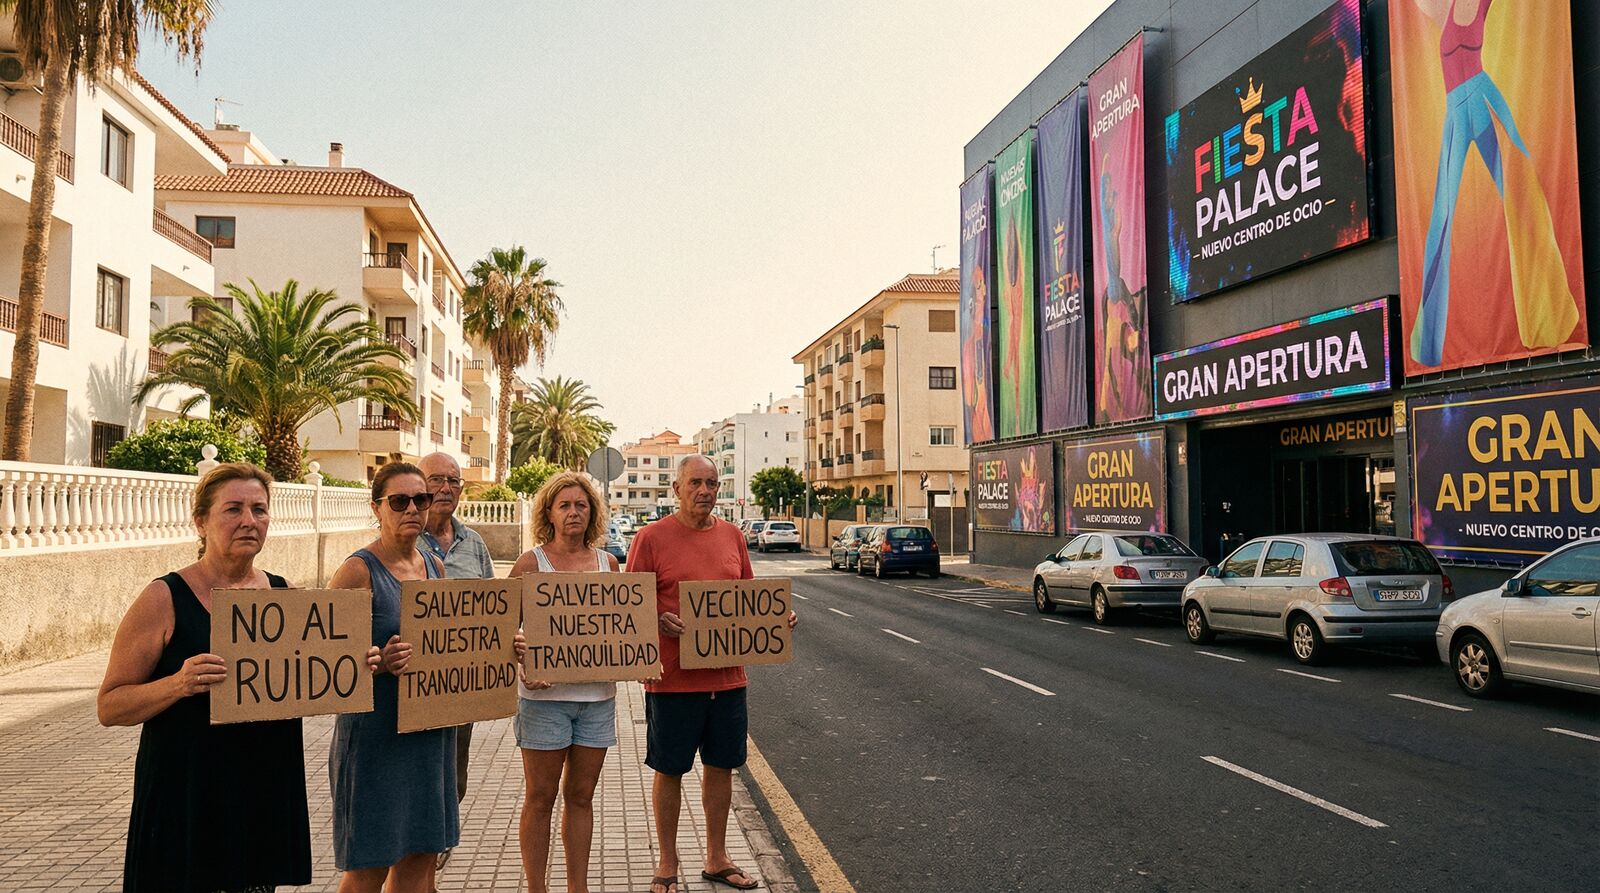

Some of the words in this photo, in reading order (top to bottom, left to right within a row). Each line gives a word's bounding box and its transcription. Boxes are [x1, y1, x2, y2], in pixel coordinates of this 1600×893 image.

[1099, 77, 1127, 112] GRAN
[1092, 93, 1140, 141] APERTURA
[1194, 86, 1319, 194] FIESTA
[1196, 141, 1321, 239] PALACE
[1201, 236, 1232, 259] NUEVO
[1233, 218, 1274, 246] CENTRO
[1276, 211, 1291, 230] DE
[1292, 199, 1322, 223] OCIO
[1044, 271, 1080, 304] FIESTA
[1045, 293, 1081, 323] PALACE
[1163, 362, 1218, 403] GRAN
[1224, 330, 1368, 393] APERTURA
[1280, 423, 1320, 446] GRAN
[1467, 407, 1600, 464] GRAN
[977, 460, 1009, 481] FIESTA
[1087, 449, 1134, 480] GRAN
[977, 482, 1009, 500] PALACE
[1073, 481, 1153, 508] APERTURA
[1121, 515, 1128, 524] DE
[1466, 523, 1507, 537] NUEVO
[1510, 524, 1564, 540] CENTRO
[1567, 526, 1587, 540] DE
[413, 589, 508, 619] SALVEMOS
[536, 582, 643, 607] SALVEMOS
[231, 602, 285, 643] NO
[302, 602, 348, 641] AL
[550, 613, 637, 636] NUESTRA
[422, 626, 501, 655] NUESTRA
